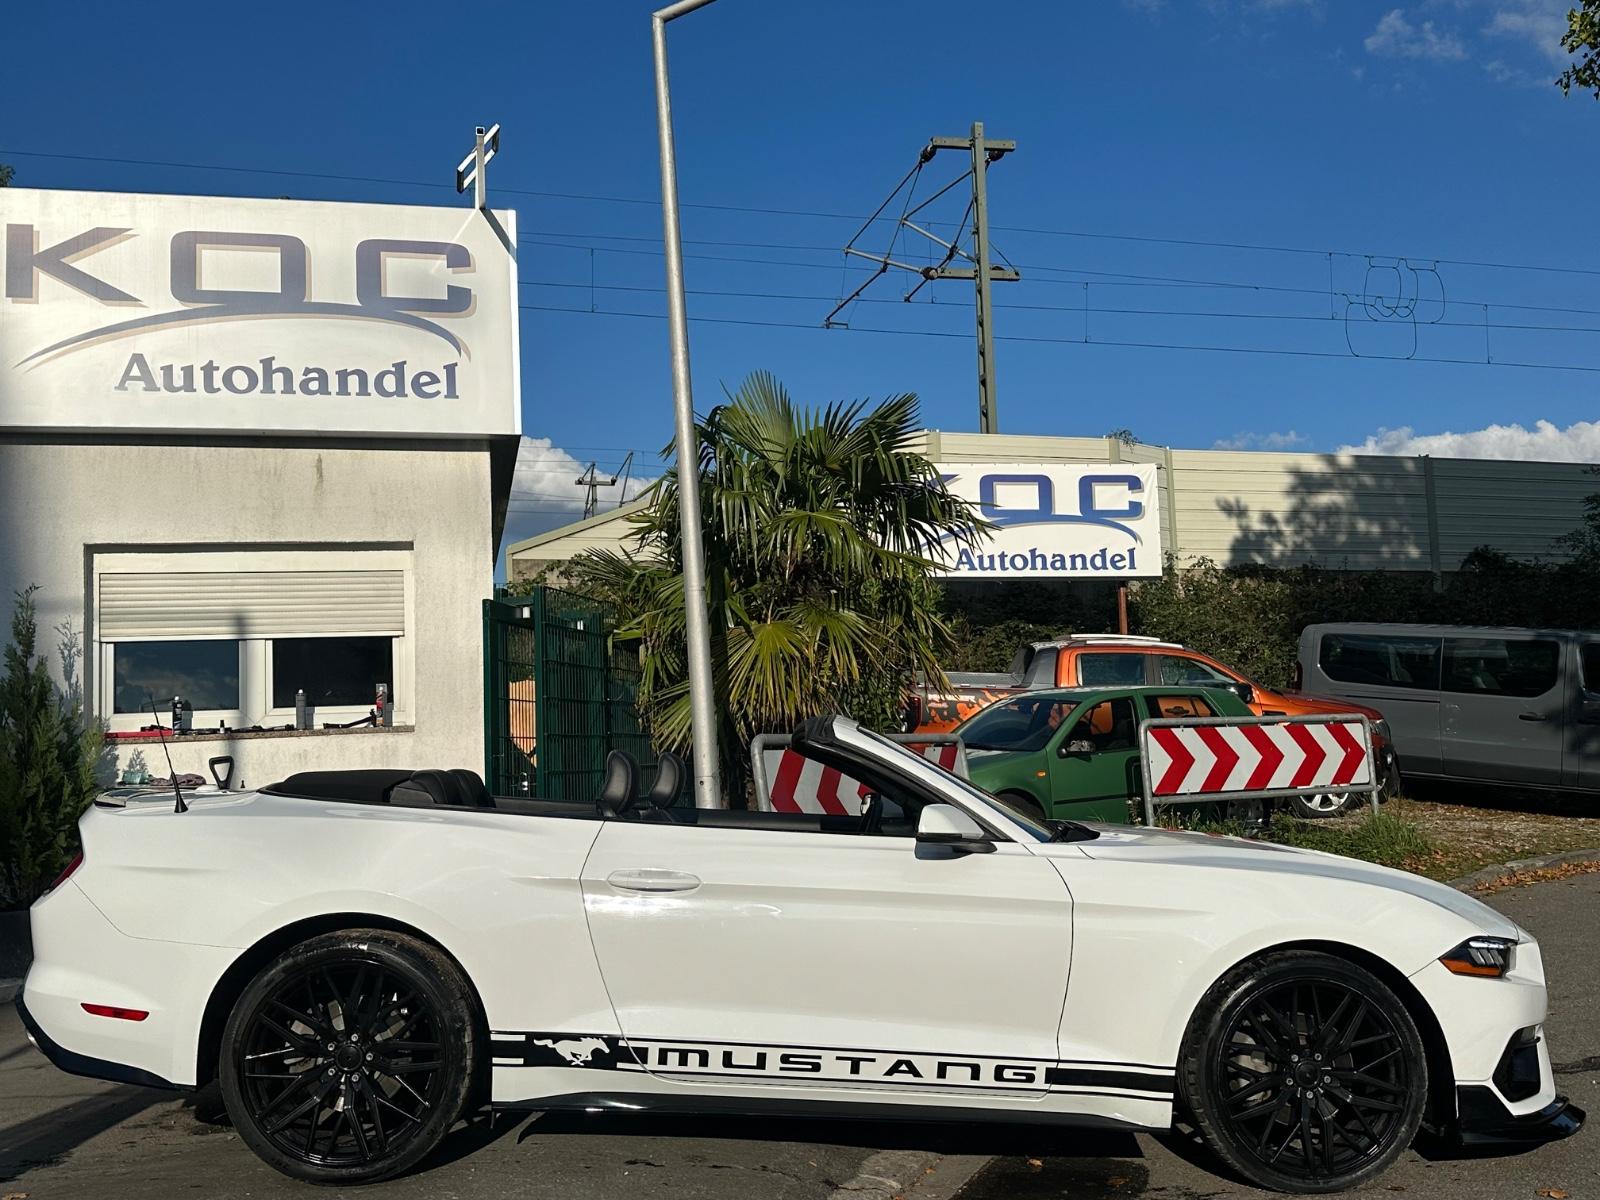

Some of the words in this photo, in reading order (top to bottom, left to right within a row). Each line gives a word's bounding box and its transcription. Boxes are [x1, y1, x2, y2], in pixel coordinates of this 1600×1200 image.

[5, 223, 477, 318] KOC
[114, 352, 460, 400] Autohandel
[955, 547, 1137, 572] Autohandel
[657, 1047, 1037, 1084] MUSTANG
